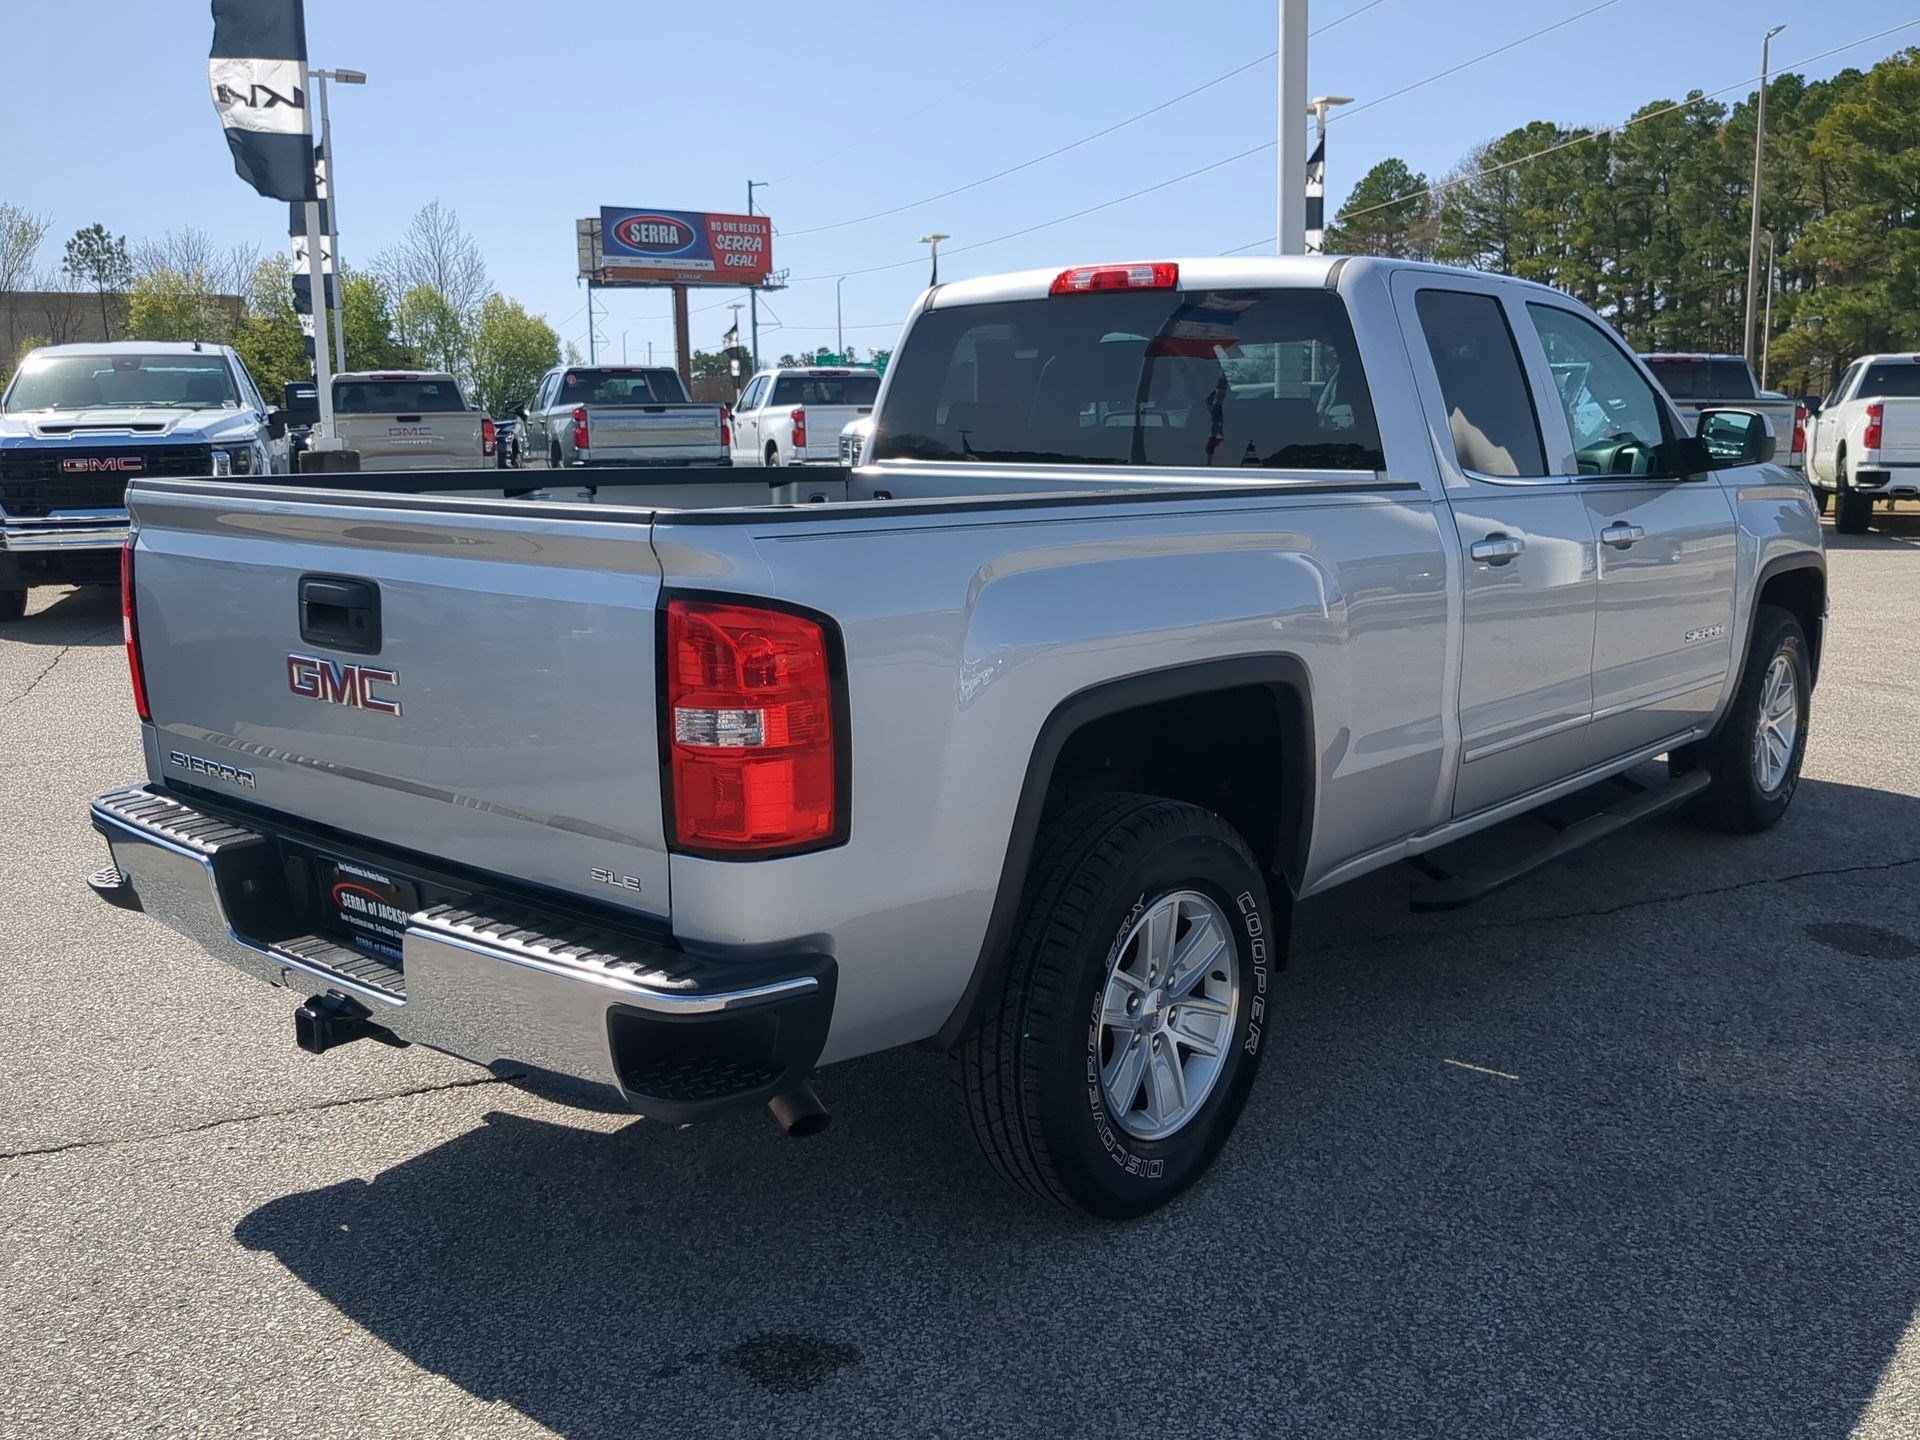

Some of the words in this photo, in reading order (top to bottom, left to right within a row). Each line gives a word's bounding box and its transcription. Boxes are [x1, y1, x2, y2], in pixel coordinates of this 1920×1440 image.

[630, 223, 680, 245] SERRA
[711, 221, 721, 231] NO
[723, 222, 737, 232] ONE
[739, 223, 760, 234] BEATS
[762, 224, 768, 234] A
[715, 234, 763, 252] SERRA
[724, 253, 758, 268] DEAL!
[63, 457, 142, 473] GMC
[287, 653, 402, 717] GMC
[171, 750, 256, 789] SIERRA
[590, 866, 642, 892] SLE
[341, 892, 367, 912] SERRA
[367, 901, 378, 916] of
[1236, 891, 1267, 1056] COOPER
[1087, 991, 1164, 1178] DISCOVERER
